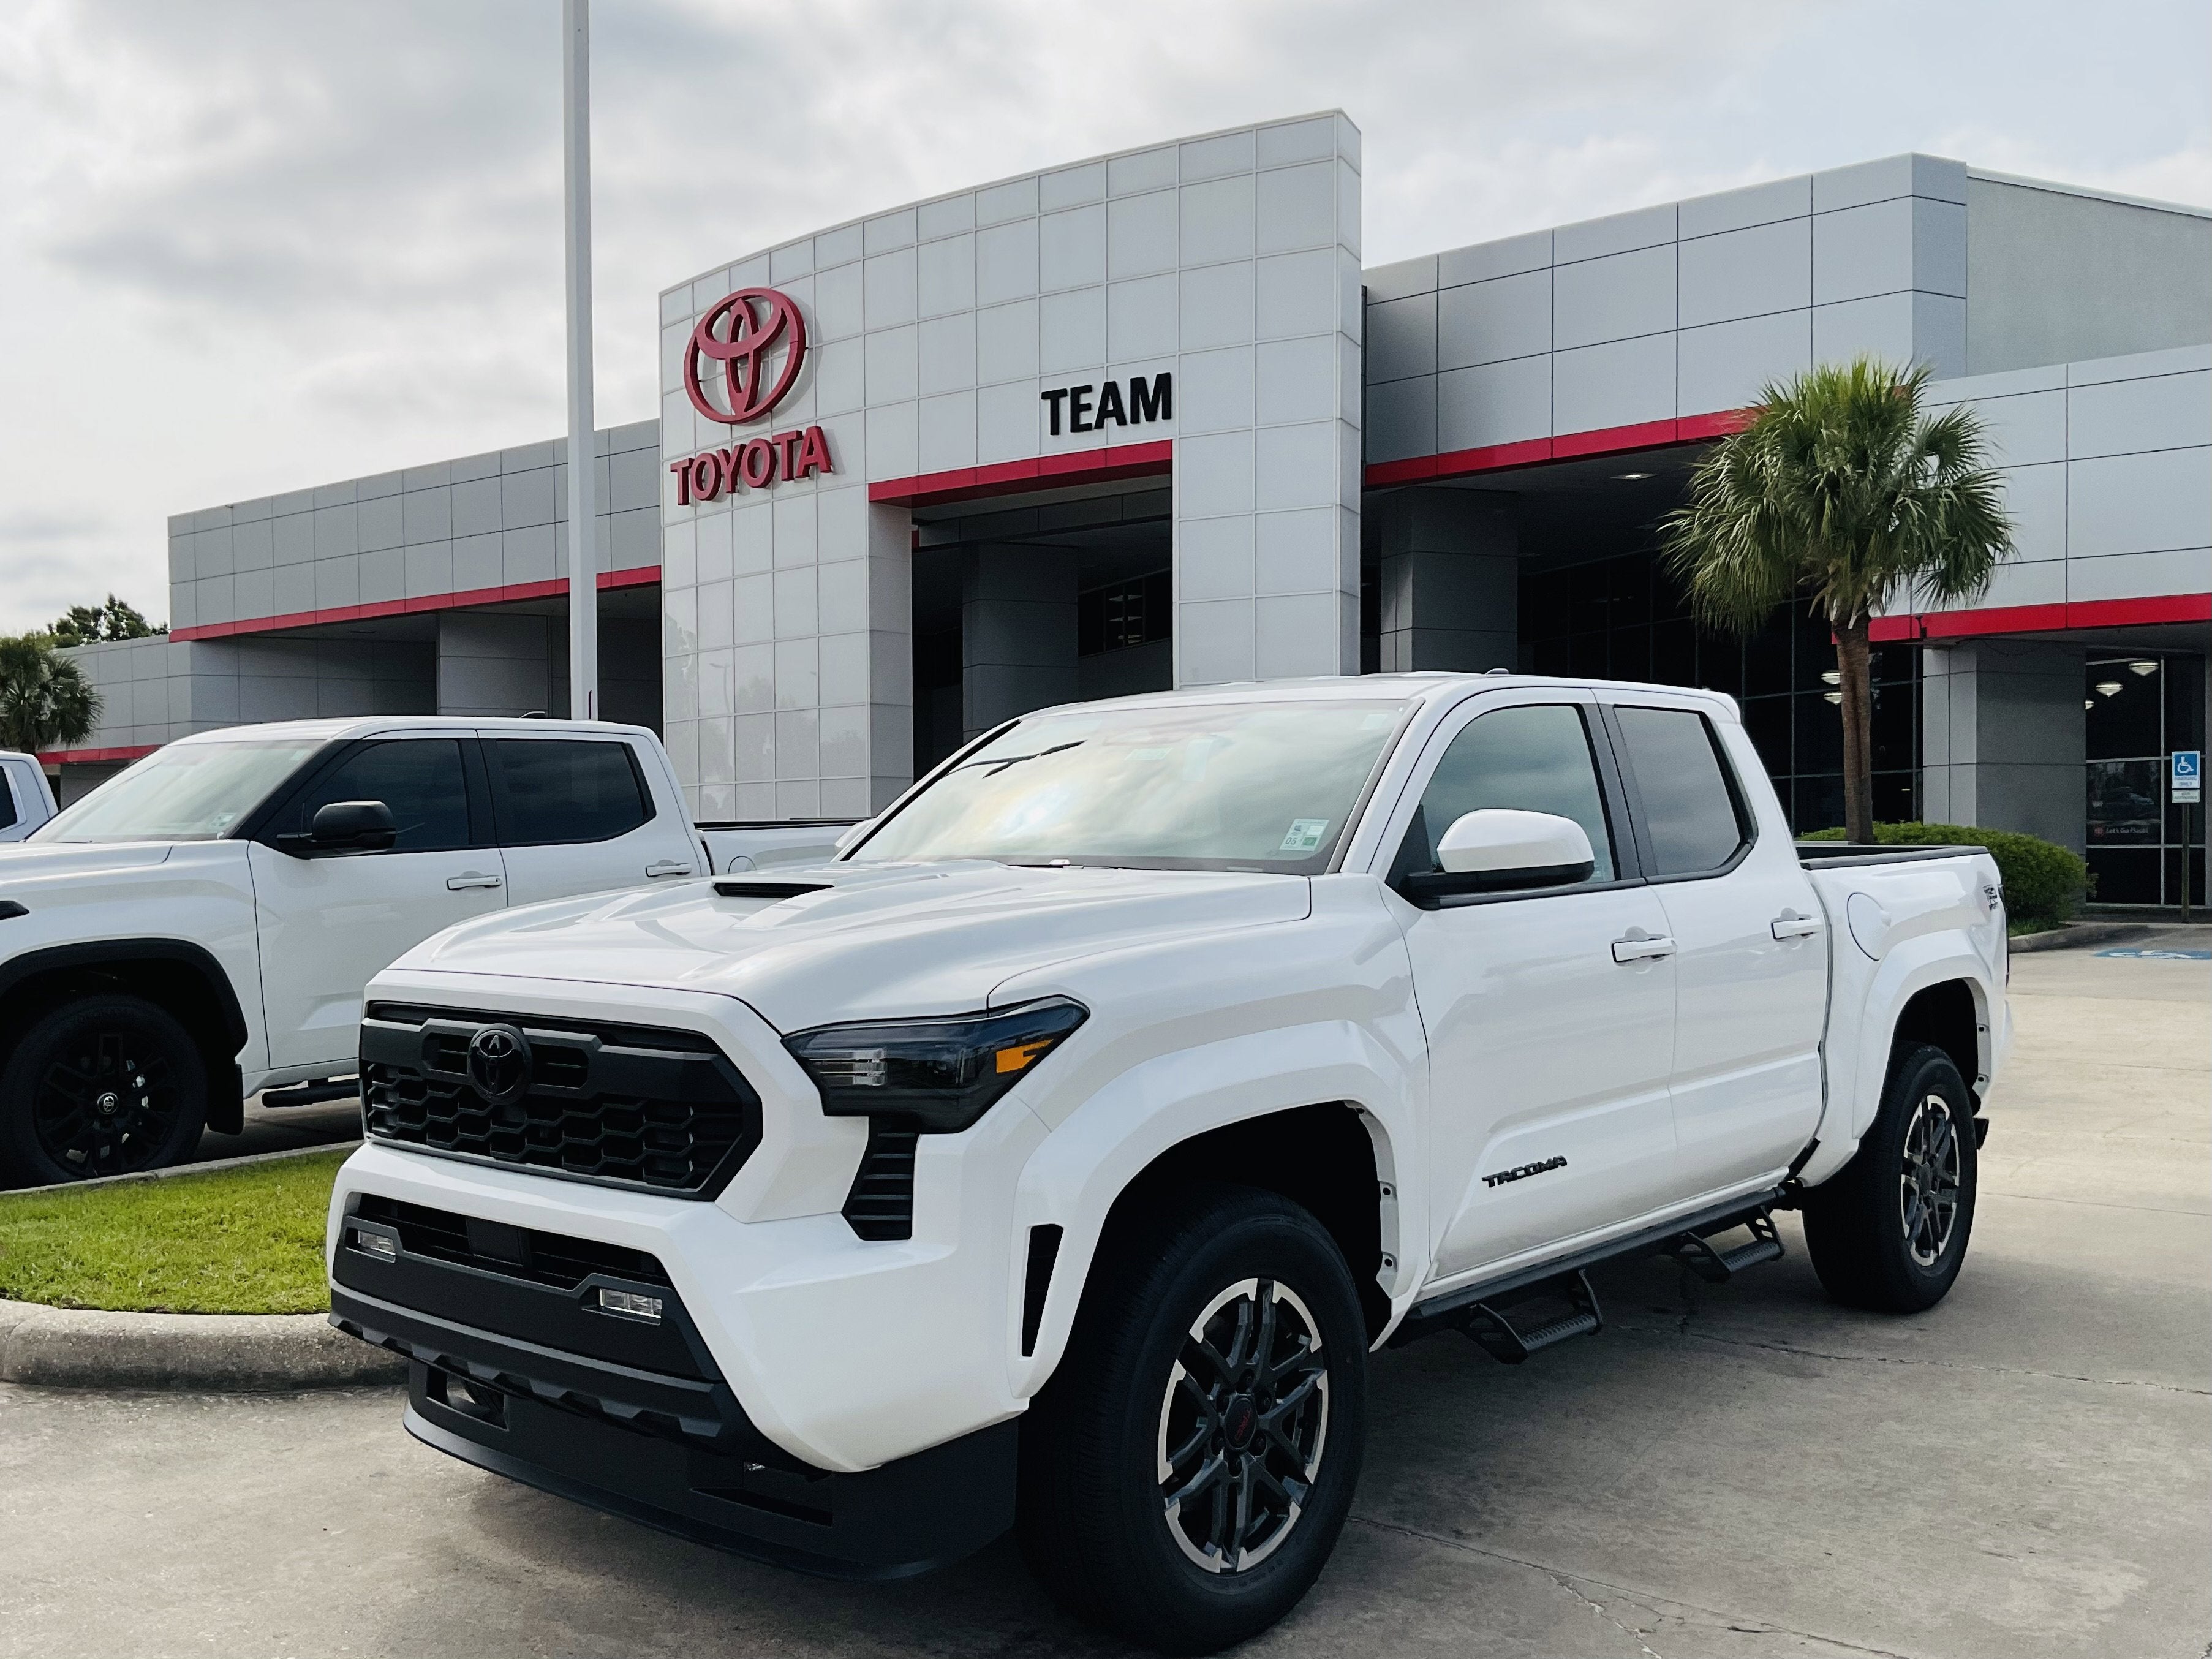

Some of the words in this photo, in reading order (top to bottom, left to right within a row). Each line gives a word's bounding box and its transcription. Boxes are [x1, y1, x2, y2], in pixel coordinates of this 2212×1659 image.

[1041, 372, 1172, 436] TEAM
[670, 426, 834, 506] TOYOTA
[1482, 1155, 1568, 1188] TACOMA
